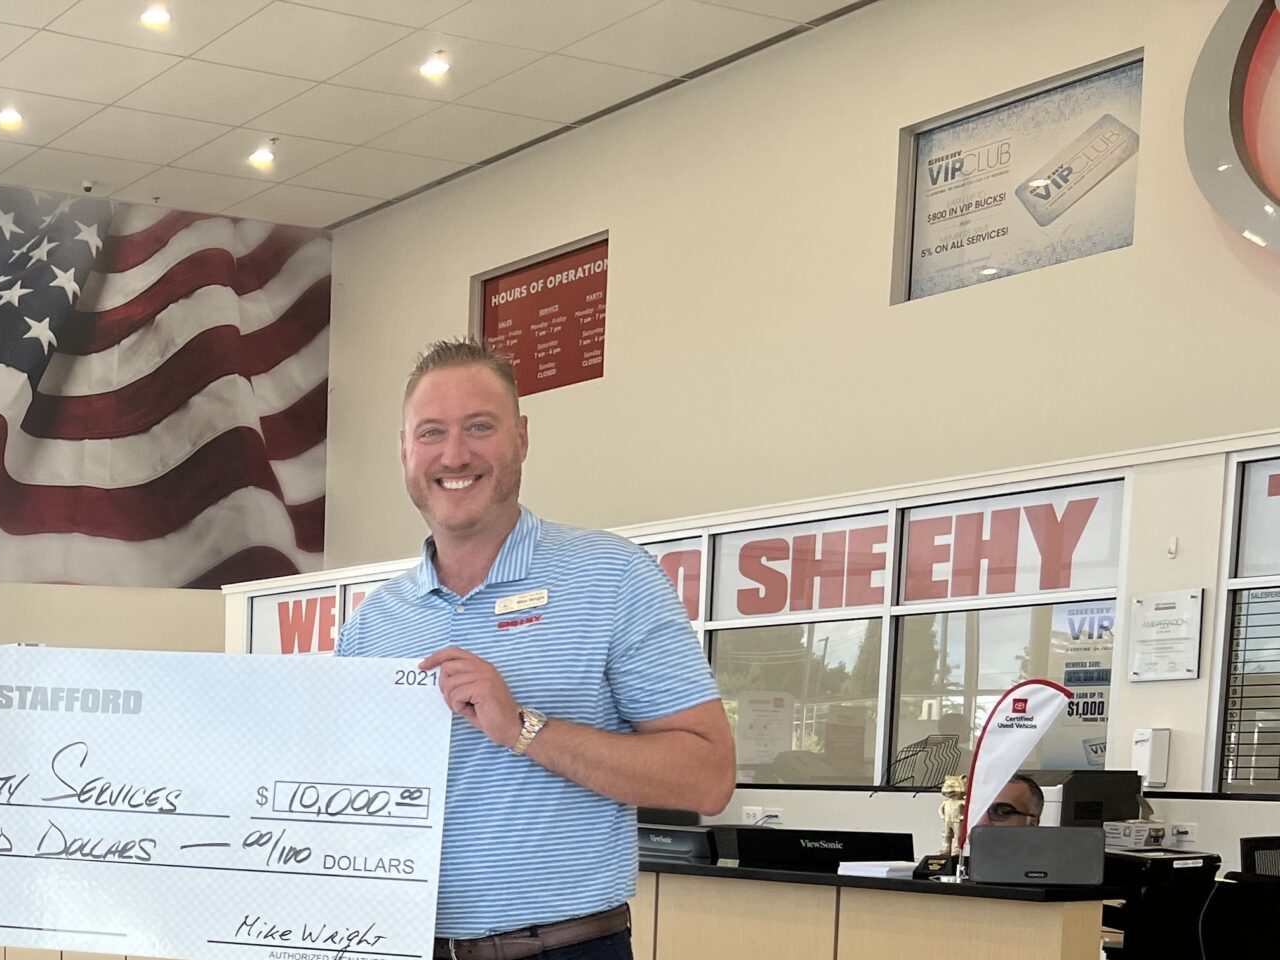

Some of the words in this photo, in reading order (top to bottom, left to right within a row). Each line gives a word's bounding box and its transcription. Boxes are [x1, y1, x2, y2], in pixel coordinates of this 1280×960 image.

[927, 209, 947, 224] $800
[949, 206, 959, 217] IN
[959, 202, 973, 214] VIP
[975, 192, 1006, 209] BUCKS!
[921, 248, 933, 258] 5%
[935, 244, 948, 255] ON
[950, 240, 965, 251] ALL
[966, 226, 1009, 246] SERVICES!
[491, 285, 527, 307] HOURS
[530, 279, 544, 294] OF
[586, 291, 603, 302] PARTS
[539, 304, 559, 316] SERVICE
[582, 356, 603, 367] CLOSED
[537, 368, 557, 379] CLOSED
[737, 497, 1099, 616] SHEEHY
[394, 669, 438, 687] 2021
[1067, 700, 1105, 718] $1,000
[256, 786, 269, 808] $
[649, 833, 672, 844] ViewSonic
[800, 839, 843, 850] ViewSonic
[322, 854, 415, 875] DOLLARS
[235, 915, 291, 943] Mike
